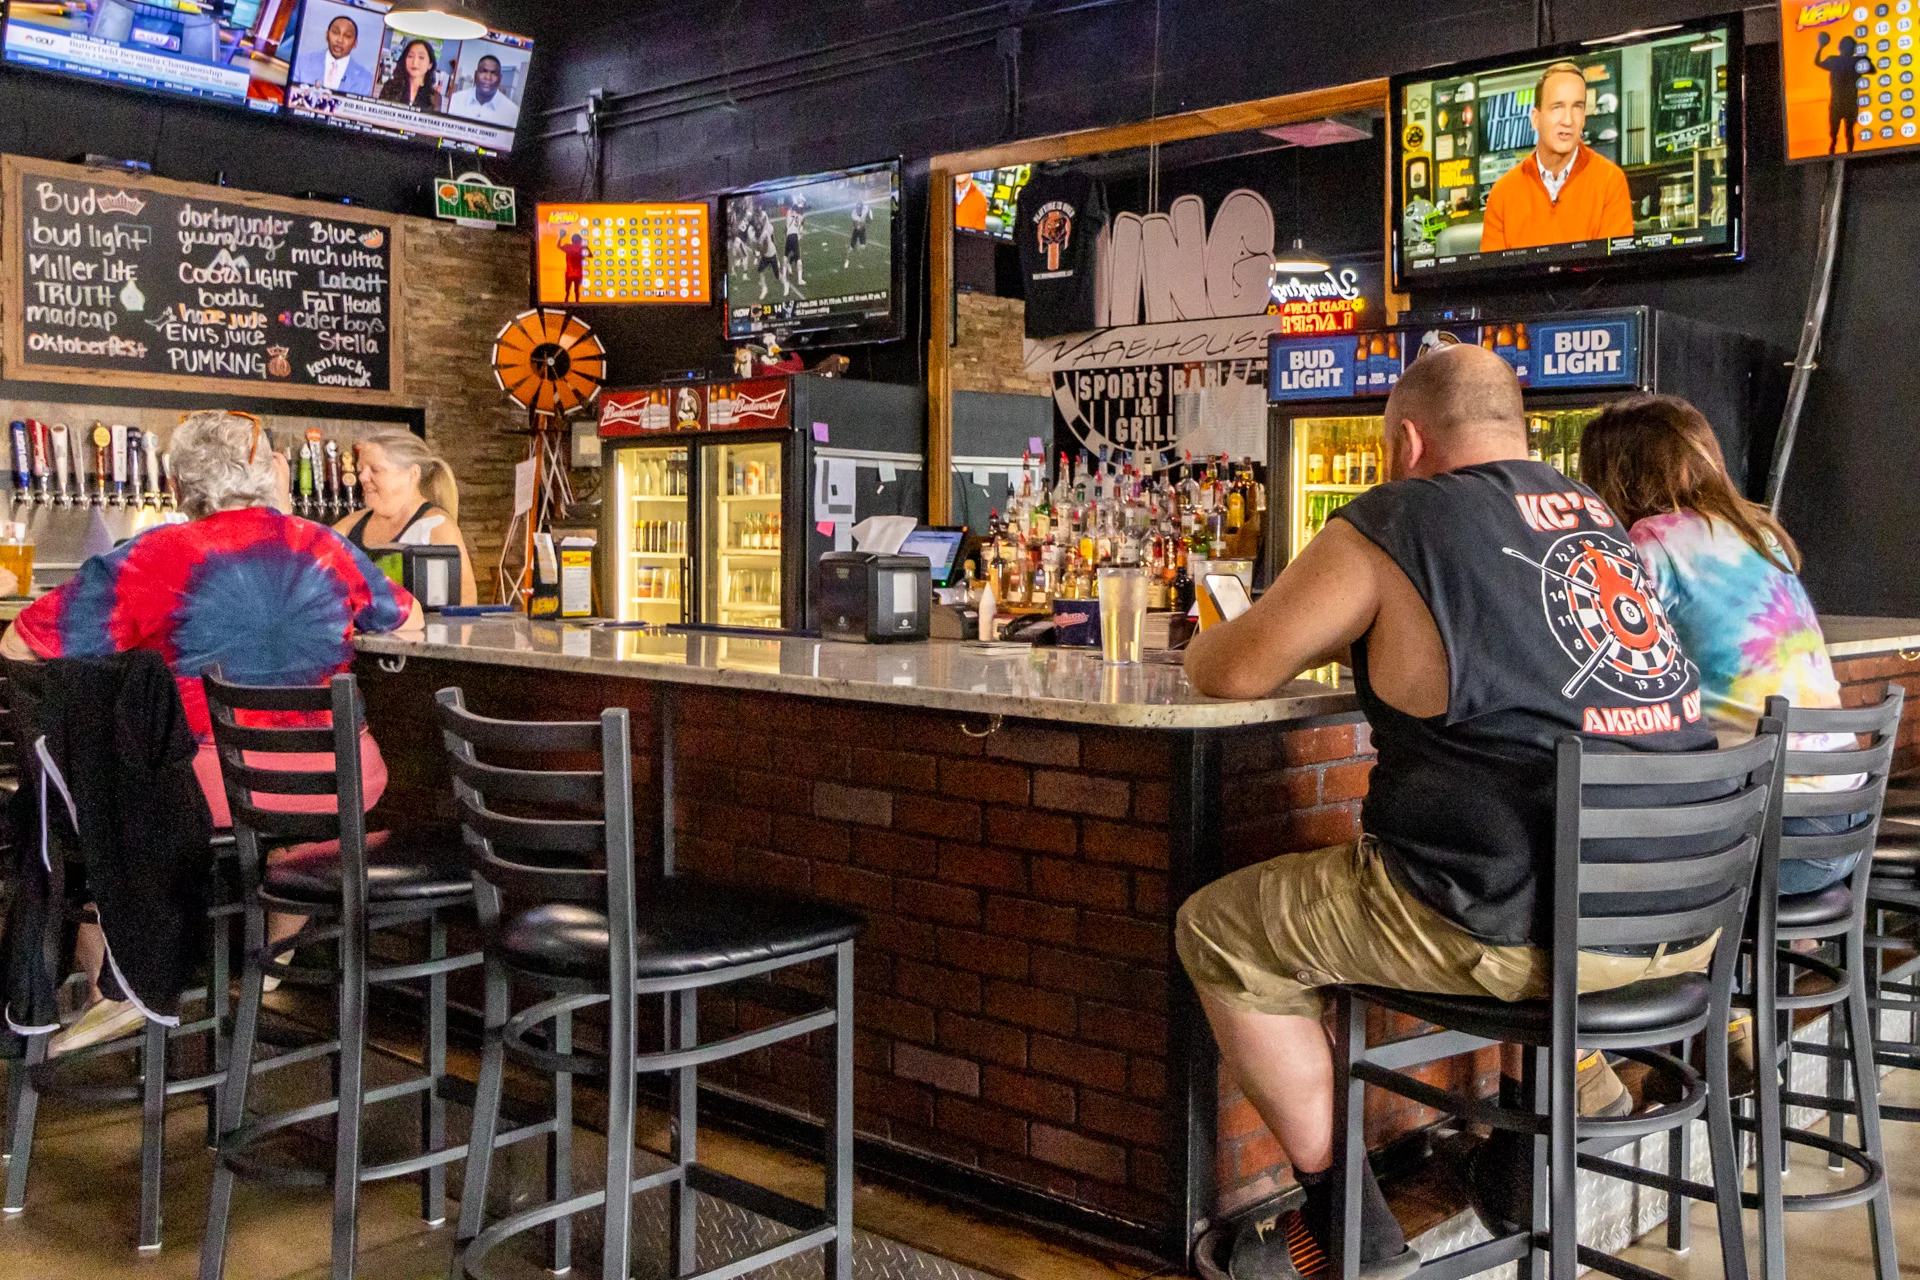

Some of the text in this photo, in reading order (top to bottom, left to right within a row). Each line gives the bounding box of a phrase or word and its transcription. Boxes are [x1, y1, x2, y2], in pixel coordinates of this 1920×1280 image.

[34, 35, 55, 46] GOLF
[68, 39, 223, 79] Butterfield Bermuda Championship
[343, 101, 354, 109] DID
[354, 104, 367, 112] BILL
[368, 107, 396, 118] BELICHICK
[396, 112, 412, 121] MAKE
[418, 117, 441, 127] MISTAKE
[440, 121, 466, 132] STARTING
[466, 126, 479, 134] MAC
[1439, 159, 1470, 170] MONDAY
[1439, 175, 1475, 188] FOOTBALL
[36, 182, 95, 216] Bud
[178, 203, 294, 235] dortmunder
[33, 217, 147, 255] bud light
[178, 226, 285, 261] yuengling
[309, 221, 357, 244] Blue
[29, 253, 98, 281] Miller
[291, 245, 384, 269] mich ultra
[179, 262, 298, 290] Coors LIGHT
[319, 270, 388, 293] Labatt
[34, 281, 115, 307] TRUTH
[343, 294, 382, 314] Head
[27, 305, 117, 332] madcap
[763, 305, 771, 315] 33
[774, 304, 782, 314] 14
[221, 329, 266, 349] juice
[318, 331, 379, 353] Stella
[1555, 329, 1610, 353] BUD
[167, 347, 267, 379] PUMKING
[306, 354, 372, 380] kentucky
[1290, 349, 1335, 370] BUD
[1544, 350, 1621, 375] LIGHT
[1079, 368, 1218, 401] SPORTS BAR
[1281, 368, 1344, 390] LIGHT
[603, 404, 645, 419] Budweiser
[733, 399, 780, 414] Budweiser
[1140, 397, 1154, 416] &
[1115, 416, 1177, 443] GRILL
[1515, 492, 1614, 532] KC'S
[1555, 553, 1570, 563] 12
[1567, 544, 1576, 553] 5
[1618, 547, 1631, 558] 18
[1549, 590, 1566, 602] 14
[1558, 614, 1574, 627] 11
[1625, 606, 1635, 618] 8
[1574, 638, 1584, 650] 8
[1615, 672, 1624, 682] 7
[1635, 679, 1648, 691] 19
[1657, 678, 1665, 689] 3
[1582, 702, 1681, 735] AKRON,
